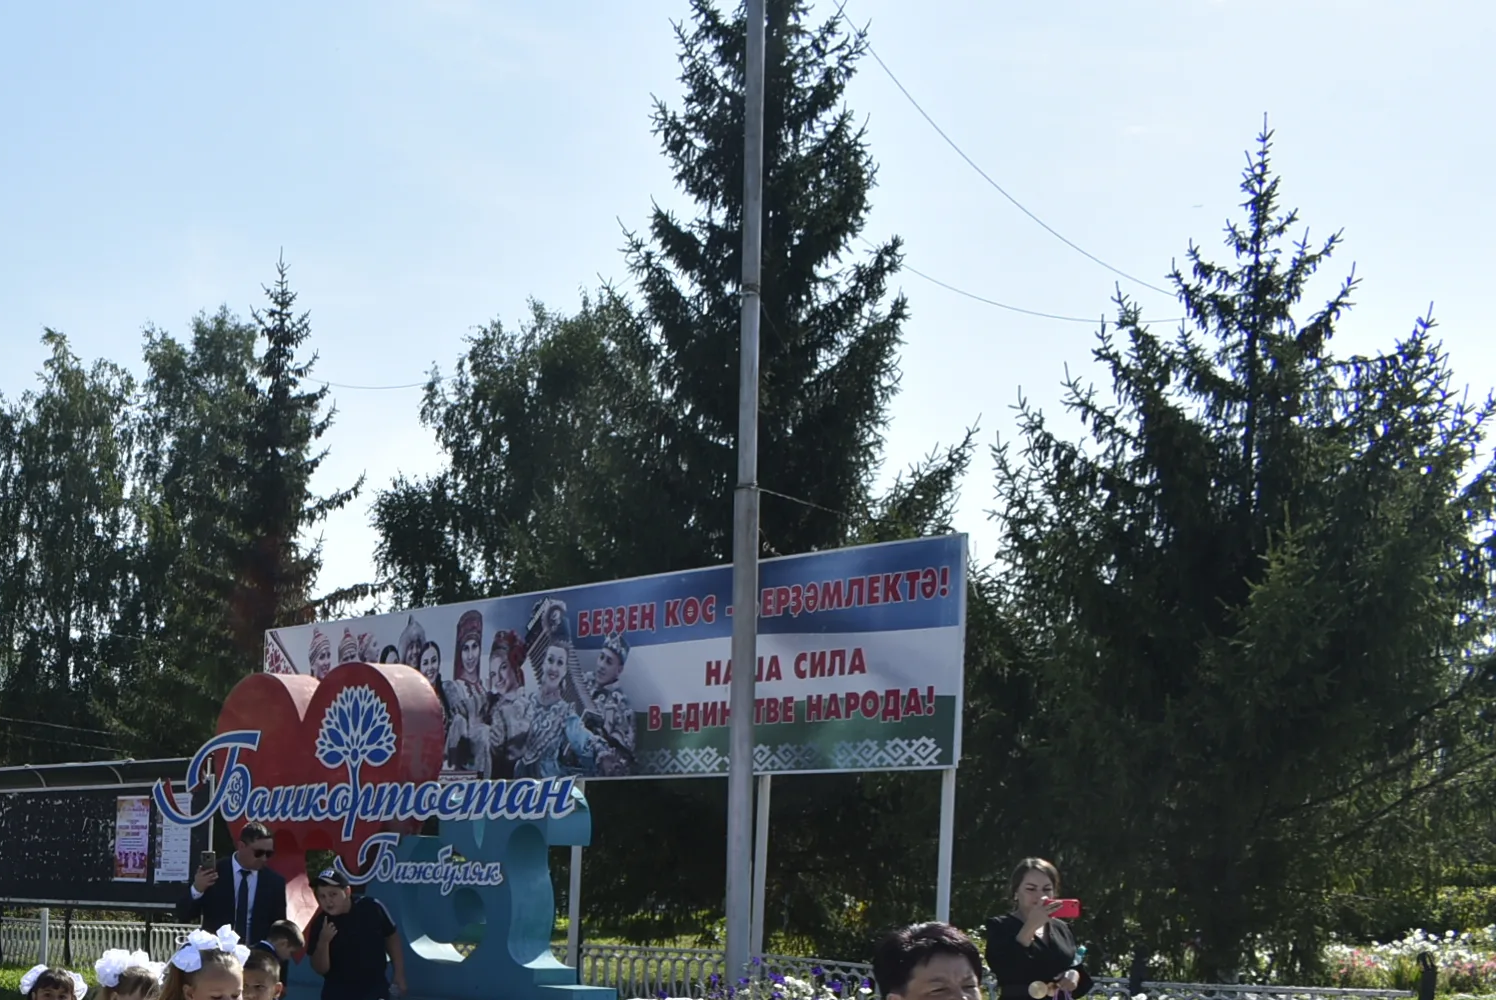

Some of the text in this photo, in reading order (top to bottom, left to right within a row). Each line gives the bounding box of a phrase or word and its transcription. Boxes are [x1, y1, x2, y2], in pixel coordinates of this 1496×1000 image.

[755, 565, 950, 618] ЕРҘӘМЛЕКТӘ!
[793, 647, 867, 680] СИЛА
[647, 685, 936, 733] В ЕДИНТВЕ НАРОДА!
[152, 730, 582, 841] Башкортостан
[333, 832, 503, 896] Бижбуляк
